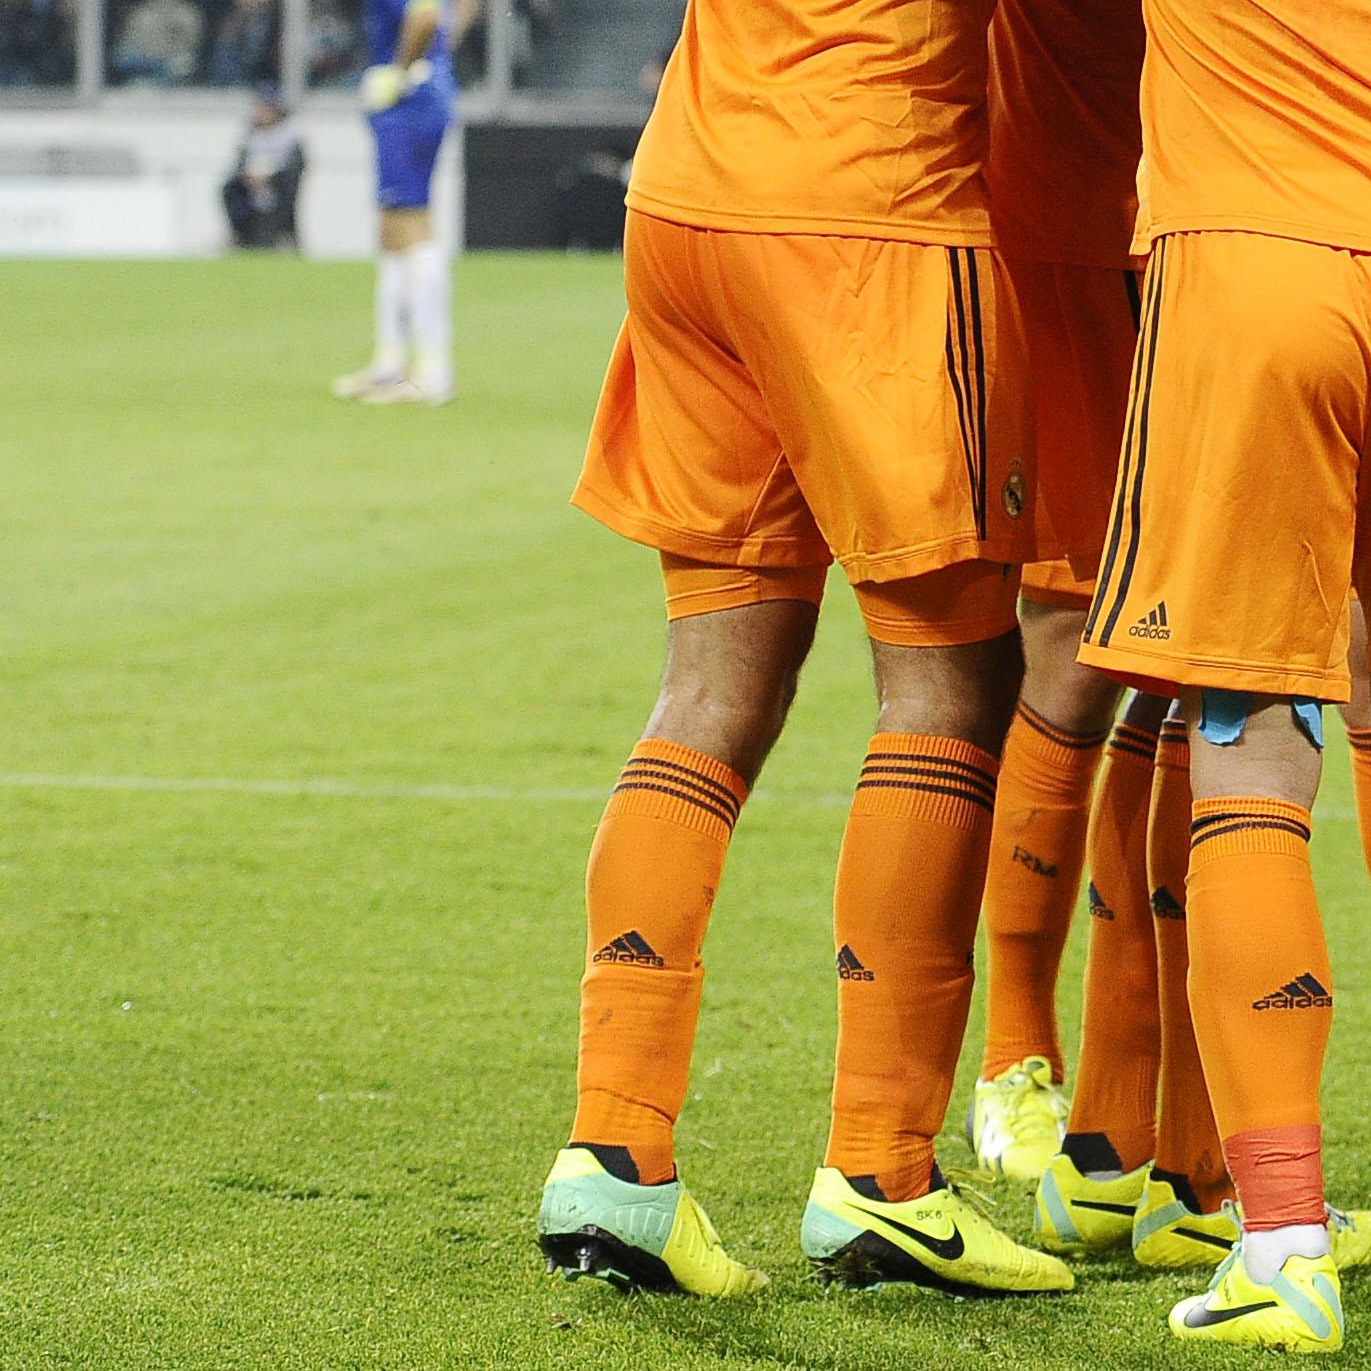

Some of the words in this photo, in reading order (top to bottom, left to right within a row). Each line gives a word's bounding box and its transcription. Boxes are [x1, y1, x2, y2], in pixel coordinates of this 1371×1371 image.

[1128, 624, 1171, 641] adidas
[593, 945, 664, 967] adidas
[838, 967, 875, 981] das
[1252, 995, 1333, 1011] adidas
